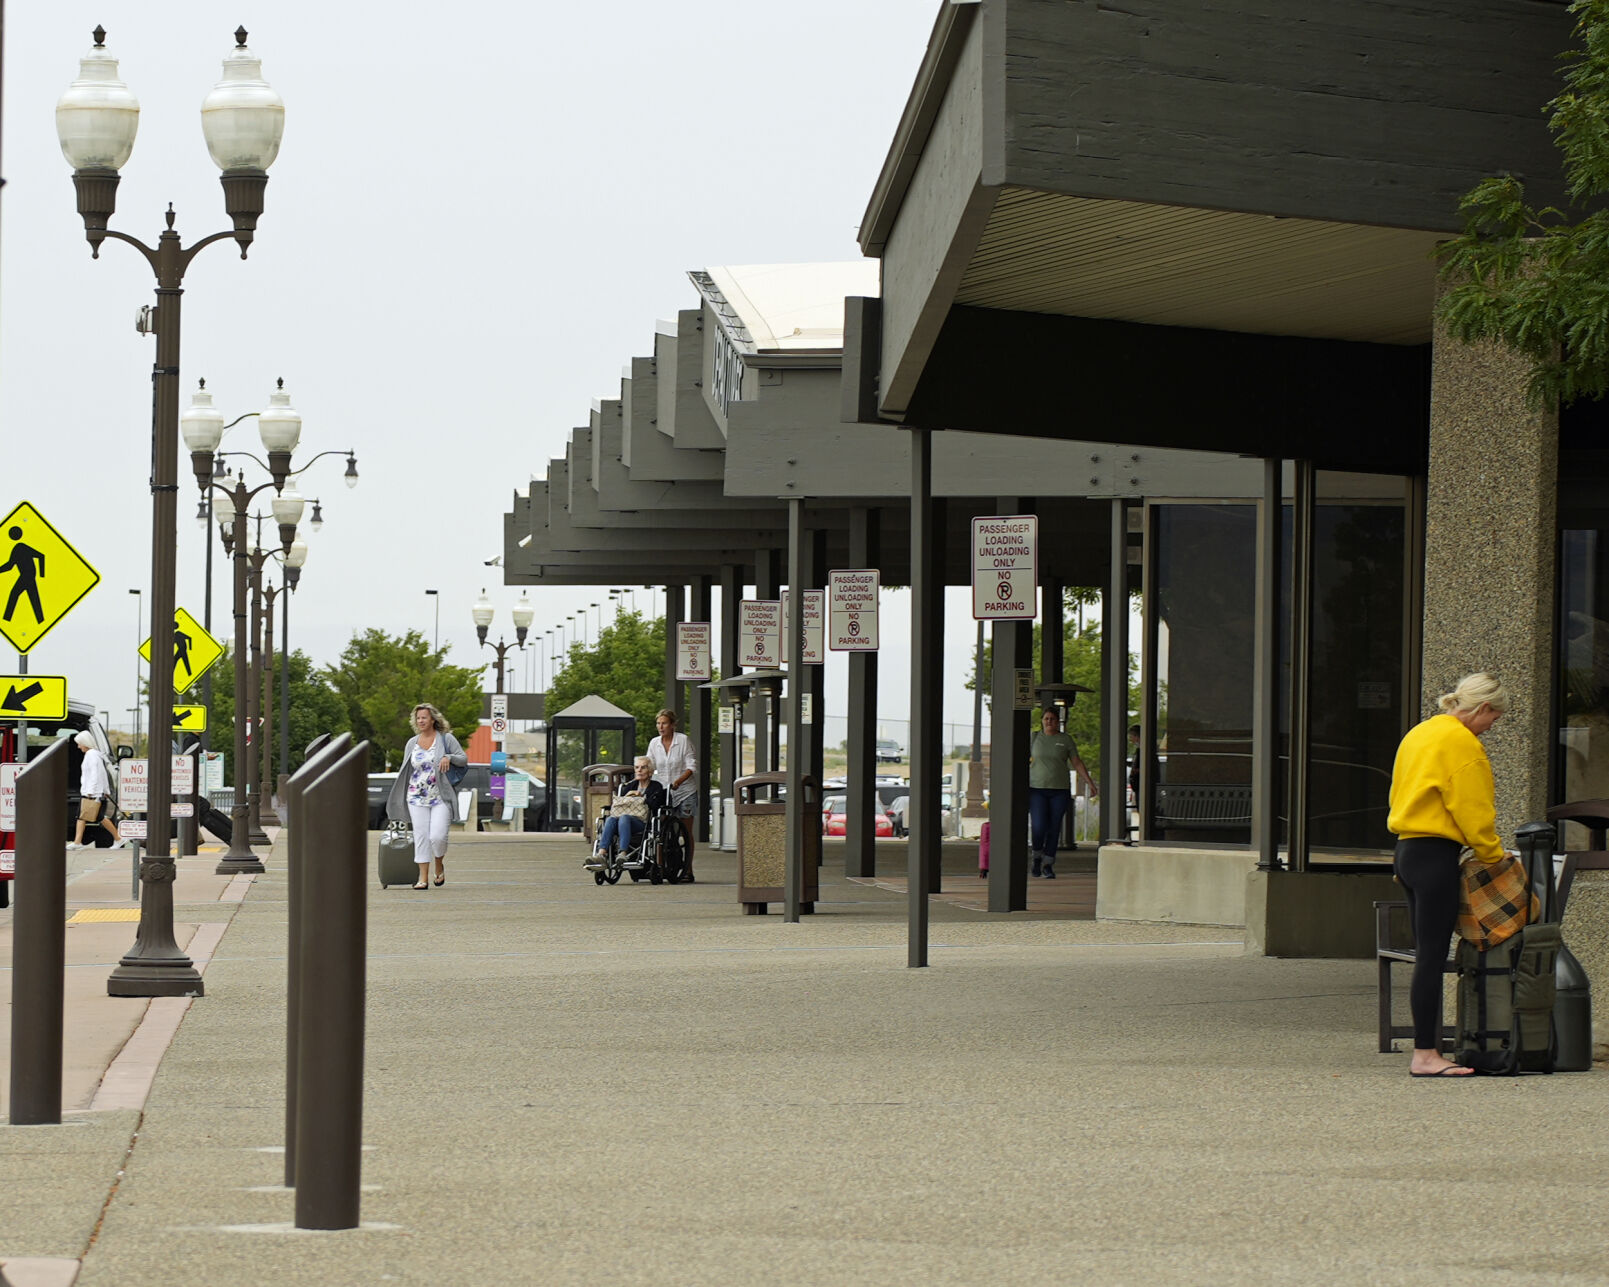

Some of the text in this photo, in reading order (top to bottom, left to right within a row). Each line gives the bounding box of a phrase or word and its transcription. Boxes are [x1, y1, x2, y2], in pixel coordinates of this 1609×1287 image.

[979, 524, 1030, 534] PASSENGER
[985, 536, 1024, 545] LOADING
[979, 547, 1030, 556] UNLOADING
[993, 559, 1016, 567] ONLY
[997, 571, 1011, 580] NO
[984, 602, 1025, 611] PARKING
[838, 637, 870, 645] PARKING
[130, 764, 144, 774] NO
